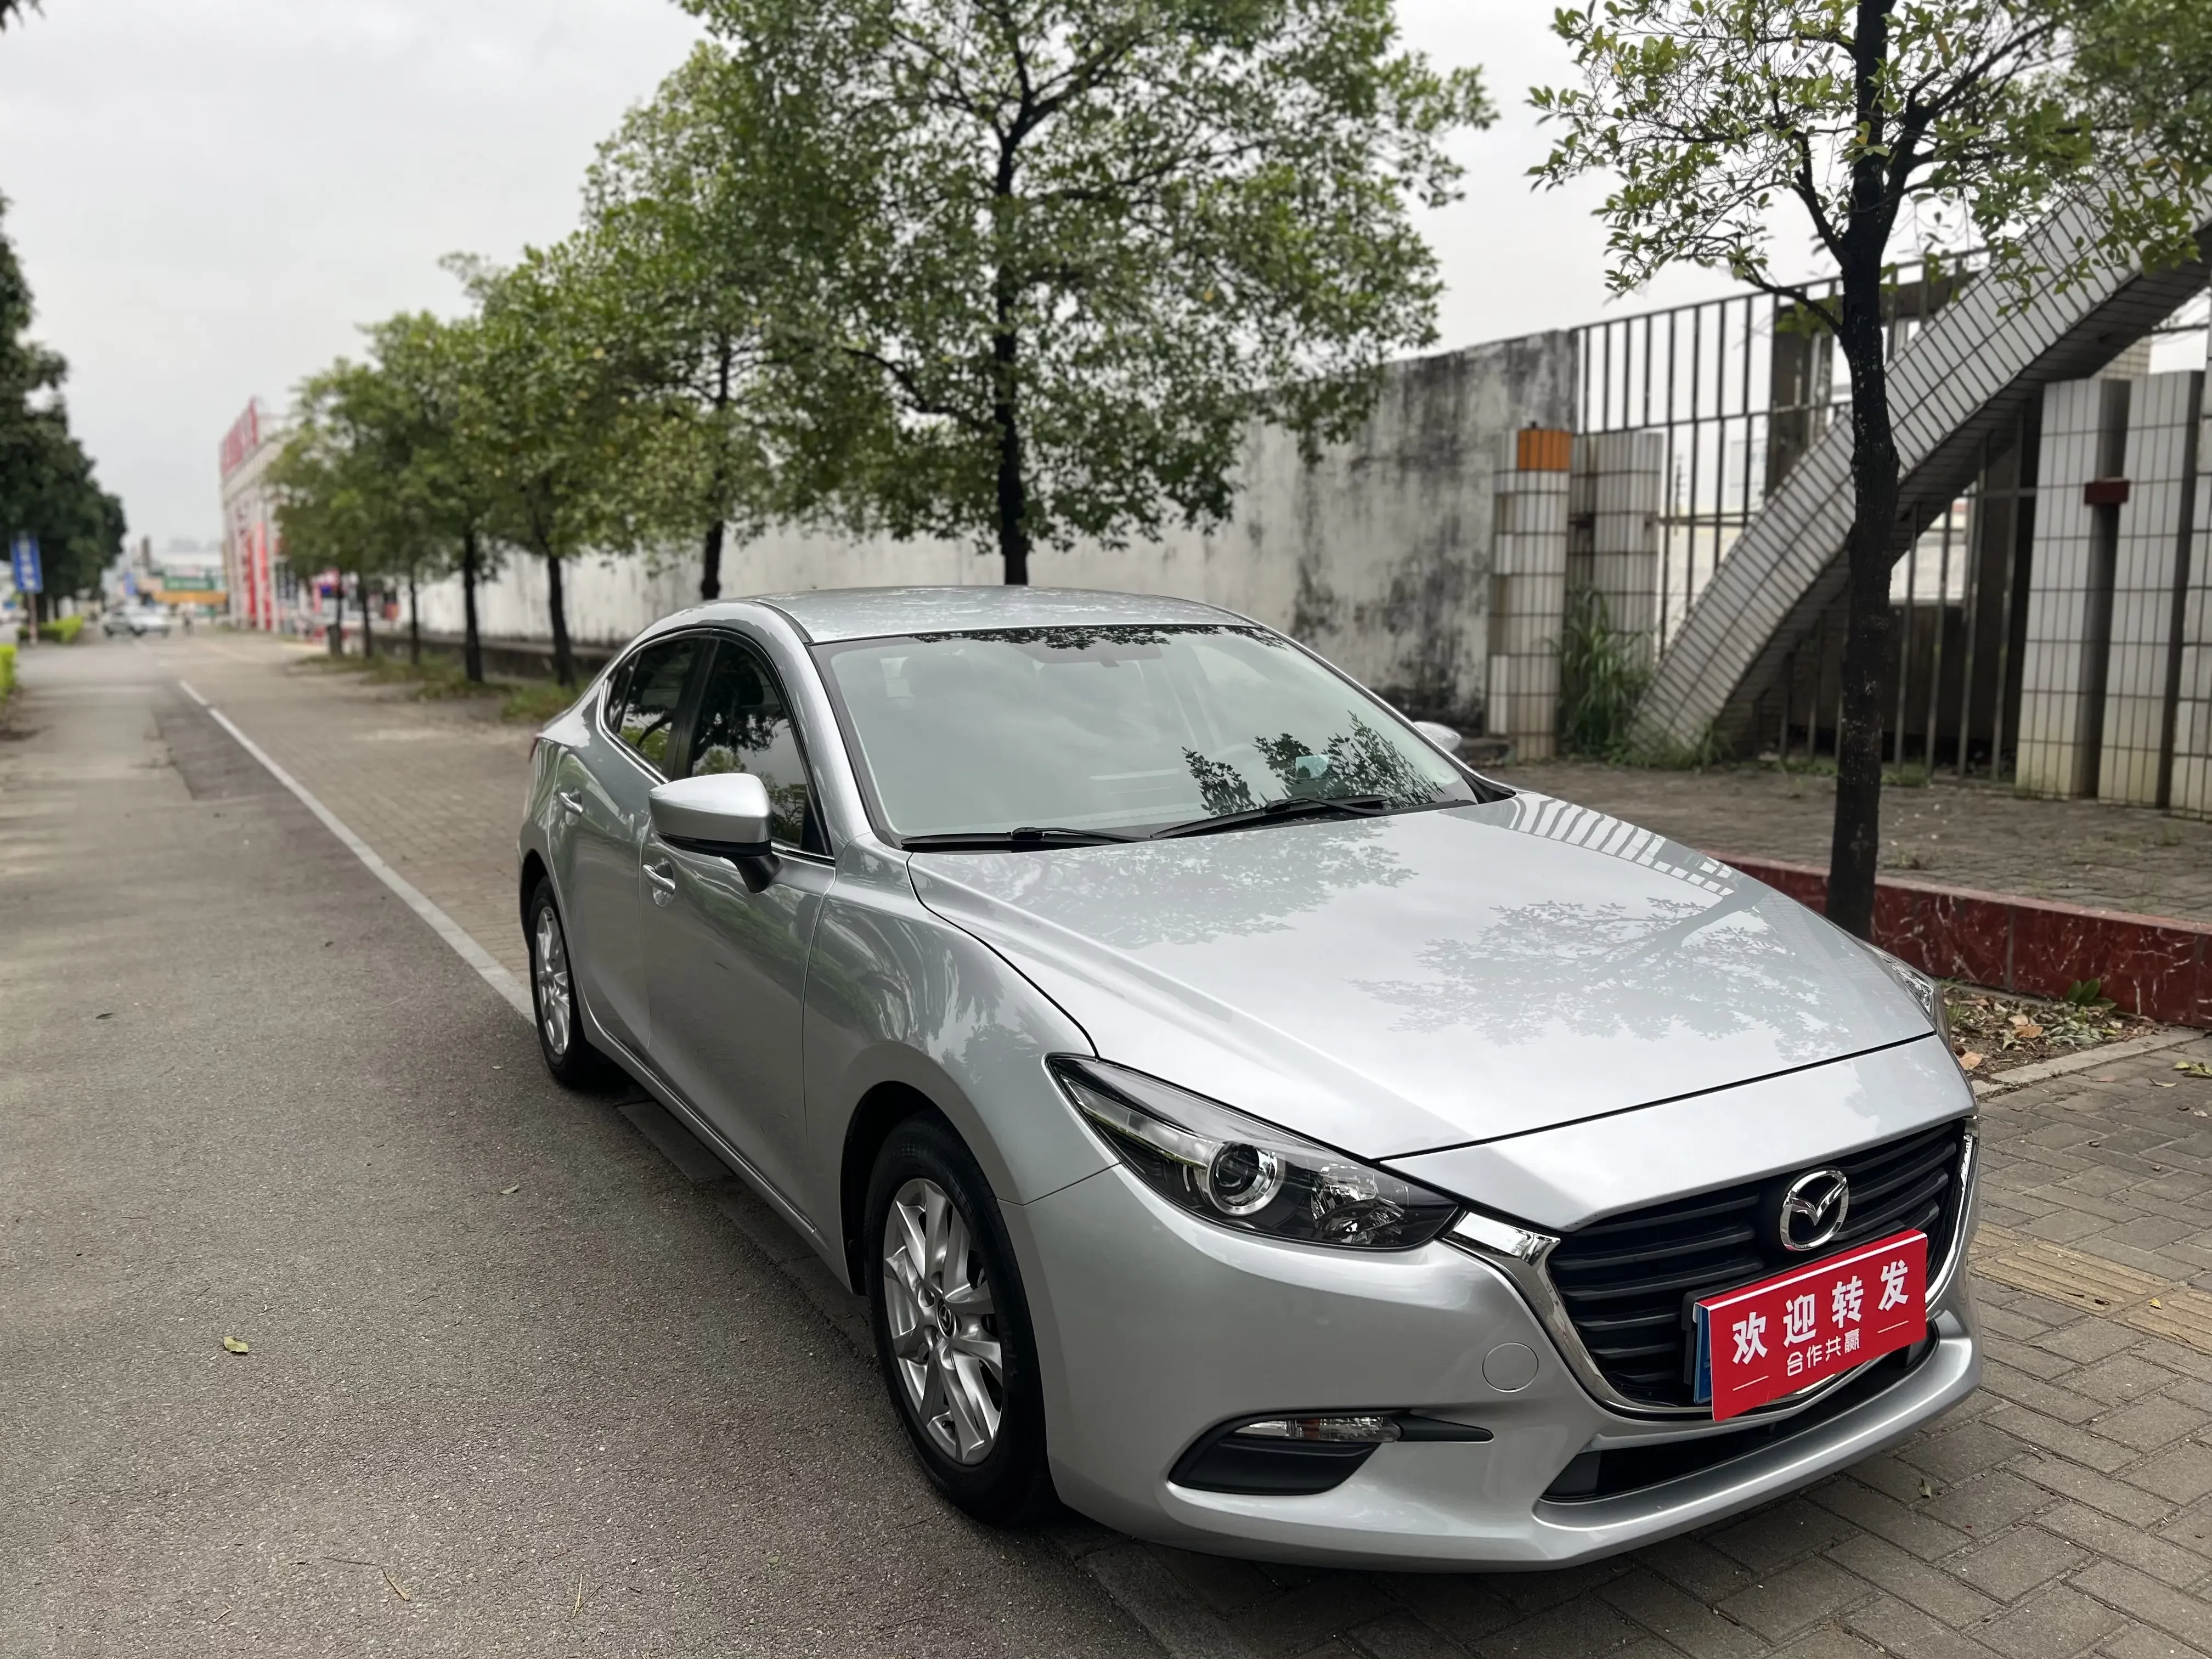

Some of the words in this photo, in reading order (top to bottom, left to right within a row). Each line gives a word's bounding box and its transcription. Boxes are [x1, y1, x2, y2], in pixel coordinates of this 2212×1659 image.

[1732, 1259, 1909, 1365] 欢迎转发
[1787, 1328, 1860, 1376] 合作共赢
